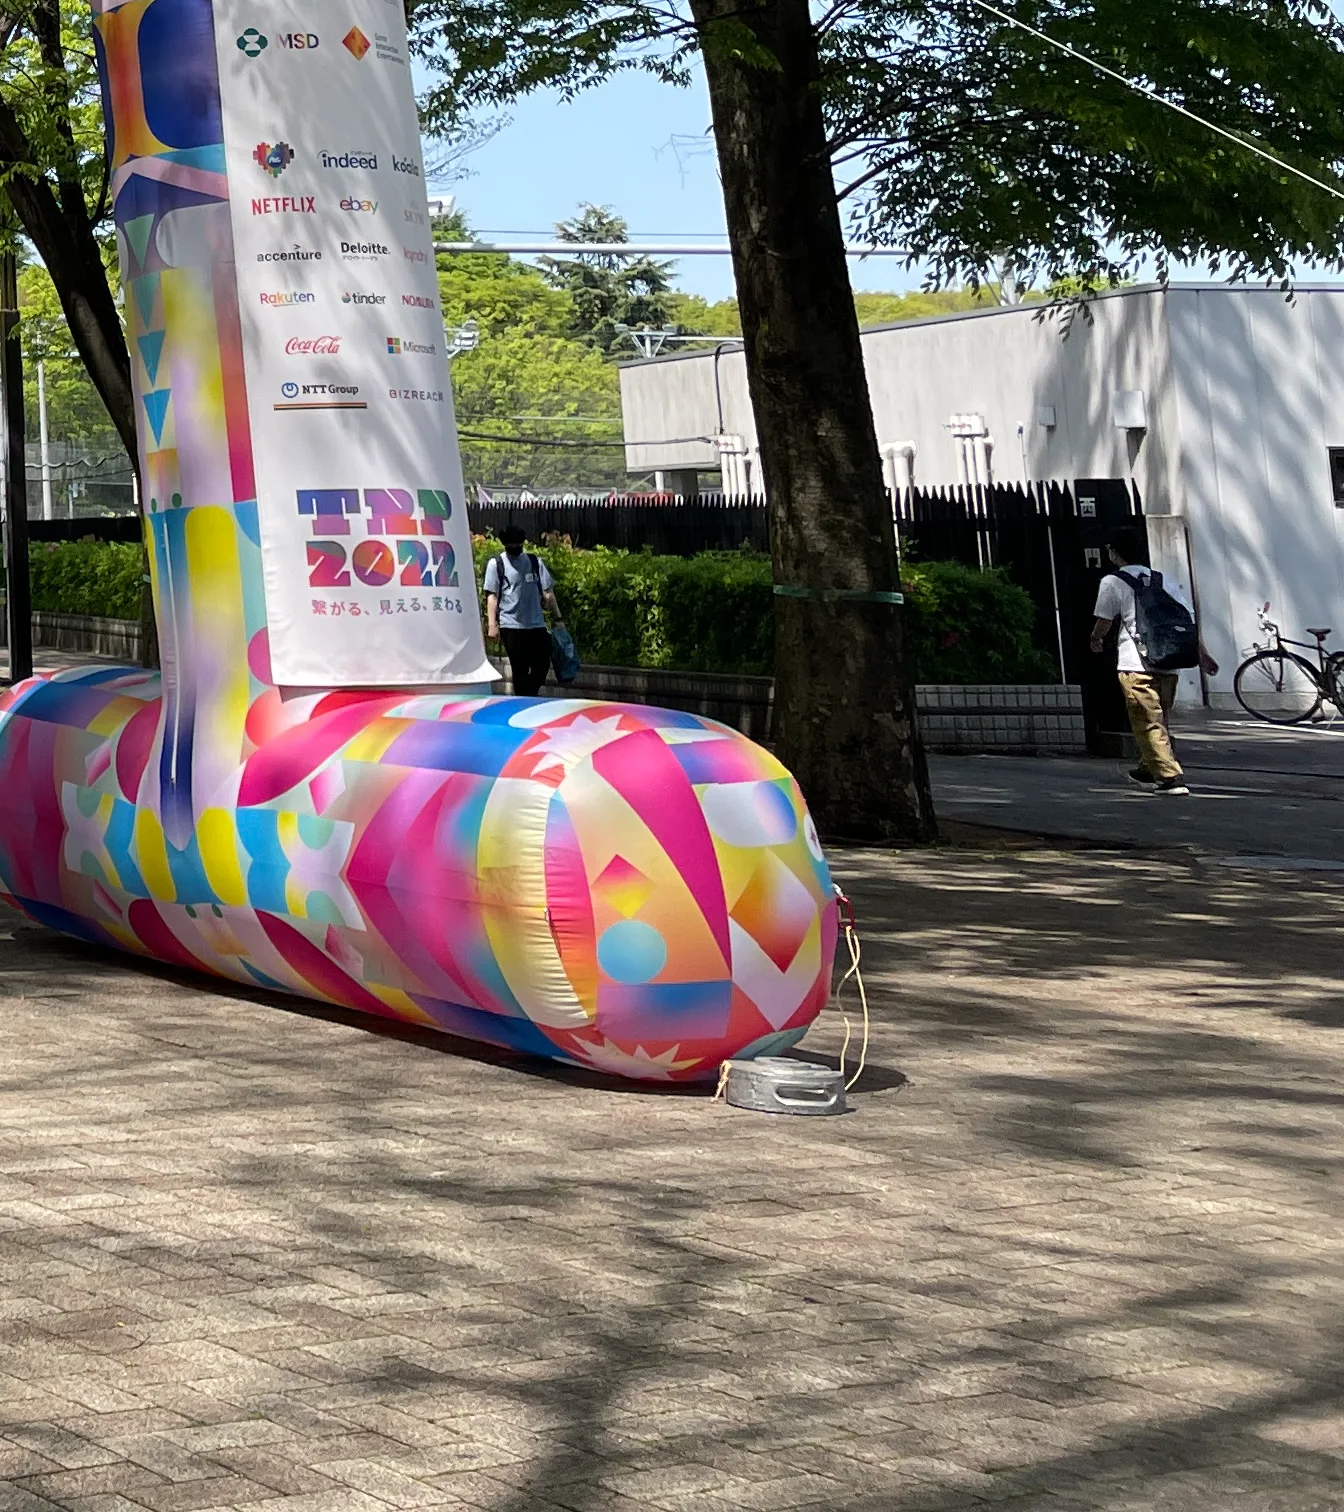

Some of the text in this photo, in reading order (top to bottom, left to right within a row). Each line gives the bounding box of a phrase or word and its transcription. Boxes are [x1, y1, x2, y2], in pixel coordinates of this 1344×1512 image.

[276, 33, 320, 51] MSD
[322, 153, 378, 170] indeed
[251, 196, 316, 216] NETFLIX
[339, 196, 379, 215] ebay
[257, 249, 322, 263] accenture
[260, 291, 315, 304] Rakuten
[352, 292, 386, 305] tinder
[296, 489, 452, 536] TRP
[1078, 497, 1102, 568] 西門
[305, 540, 459, 587] 2022
